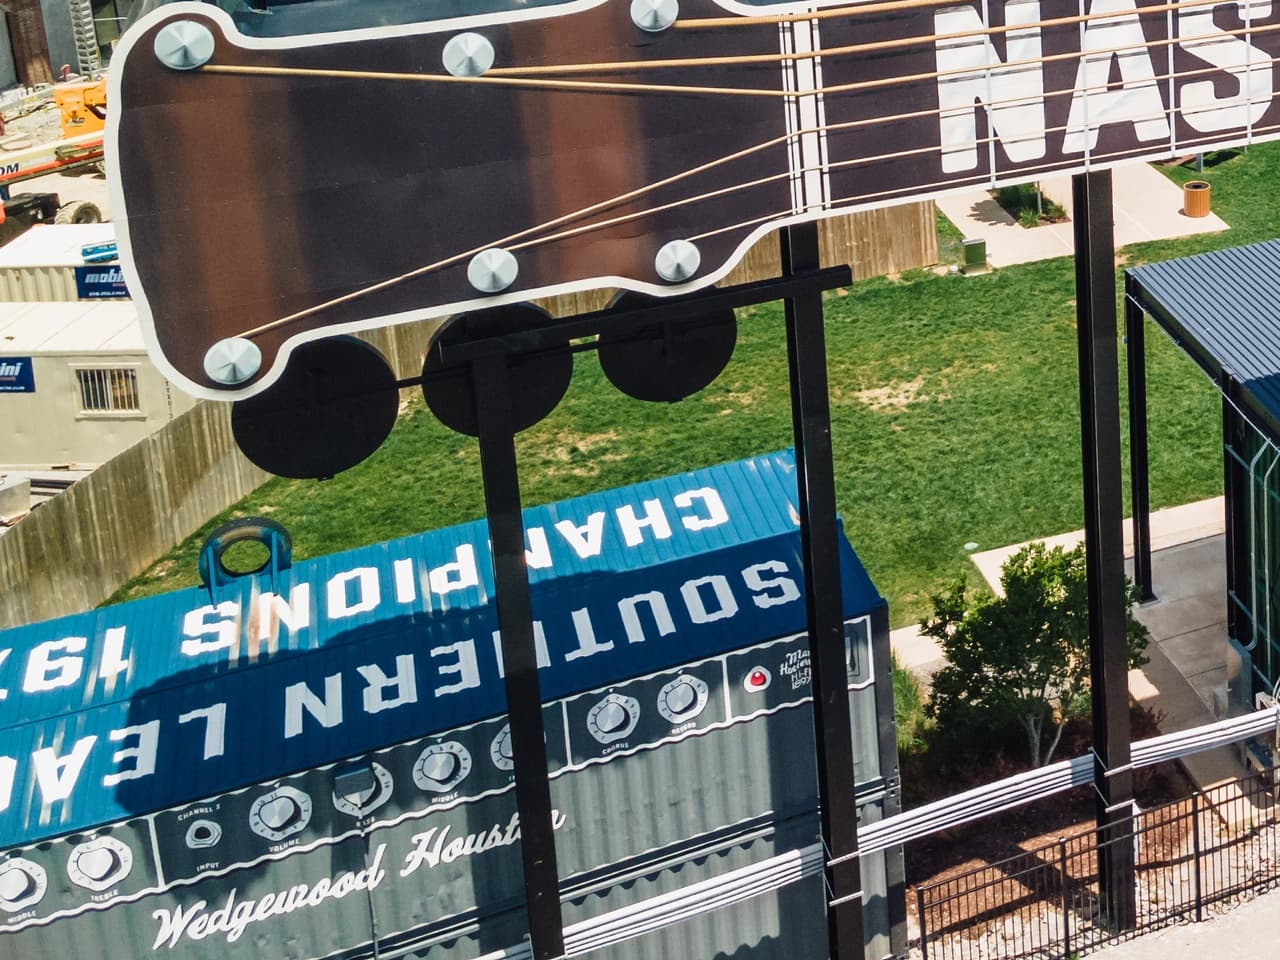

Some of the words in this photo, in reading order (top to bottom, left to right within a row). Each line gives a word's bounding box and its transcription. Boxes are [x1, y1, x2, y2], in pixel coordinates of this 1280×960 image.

[0, 625, 129, 700] 19
[602, 742, 629, 755] CHORUS
[431, 791, 459, 804] MIDDLE
[177, 807, 213, 821] CHANNEL
[269, 839, 299, 852] VOLUME
[197, 862, 219, 872] INPUT
[152, 843, 388, 951] Wedgewood
[400, 809, 566, 877] Houstn
[8, 910, 36, 923] MIDDLE
